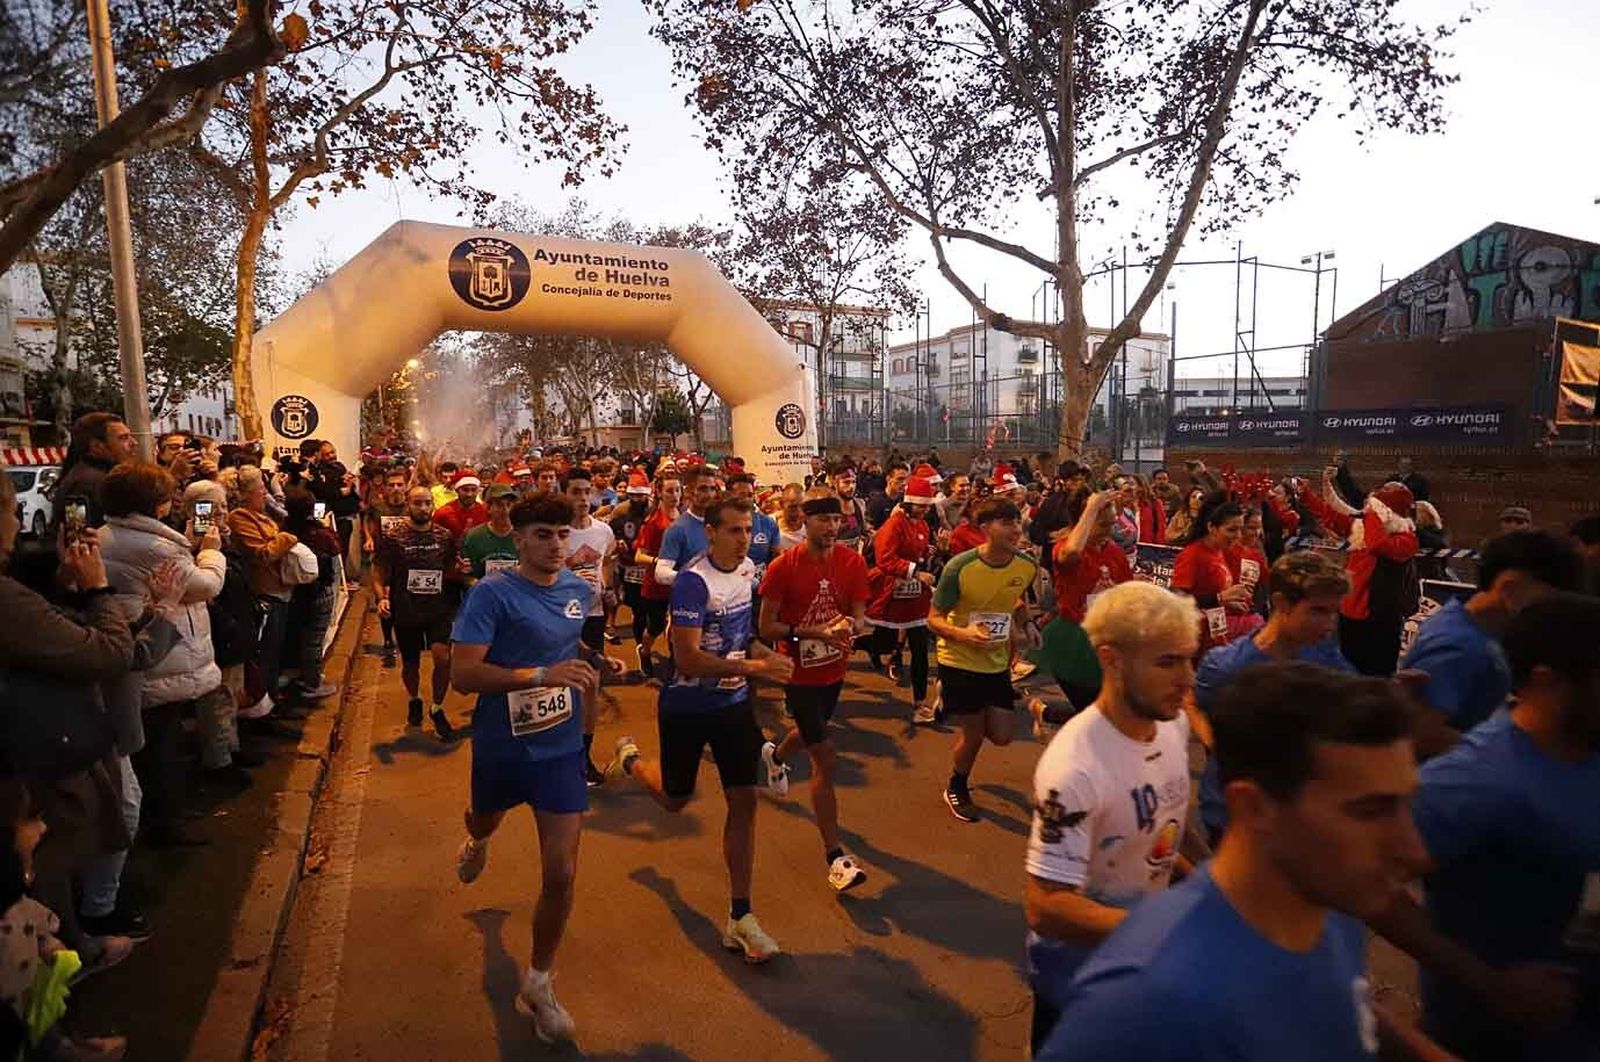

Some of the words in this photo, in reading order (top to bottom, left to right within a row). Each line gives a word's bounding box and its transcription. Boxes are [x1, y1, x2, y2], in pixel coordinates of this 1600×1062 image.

[534, 249, 669, 271] Ayuntamiento
[575, 267, 598, 282] de
[605, 269, 670, 287] Huelva
[606, 288, 620, 298] de
[623, 289, 672, 300] Deportes
[1256, 420, 1299, 428] HYUNDAI
[1344, 417, 1396, 427] HYUNDAI
[1436, 413, 1499, 425] HYUNDAI
[1191, 422, 1229, 431] HYUNDAI
[538, 694, 566, 717] 548
